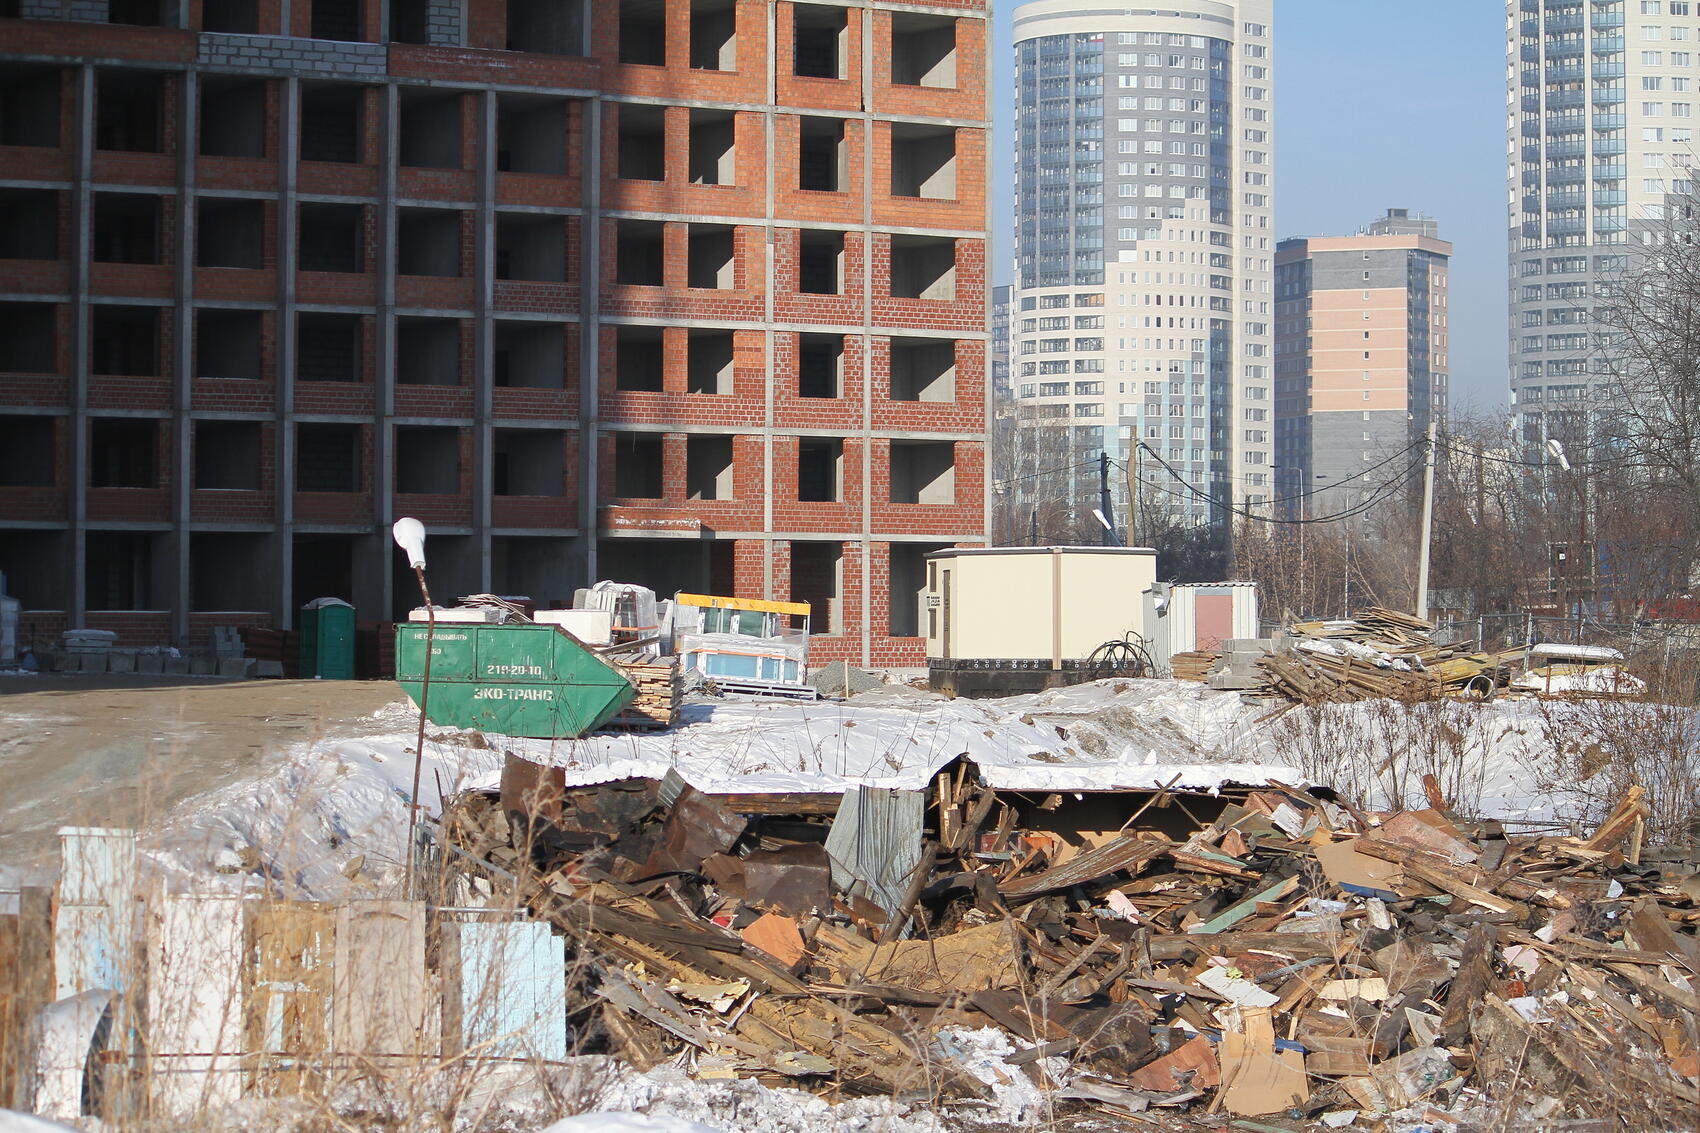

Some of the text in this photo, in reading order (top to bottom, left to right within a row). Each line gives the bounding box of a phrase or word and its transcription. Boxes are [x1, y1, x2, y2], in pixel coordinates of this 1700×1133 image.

[424, 633, 468, 641] СЛАДЫВАТЬ
[487, 665, 542, 676] 219-20-10
[473, 688, 553, 701] ЭКО-ТРАНС
